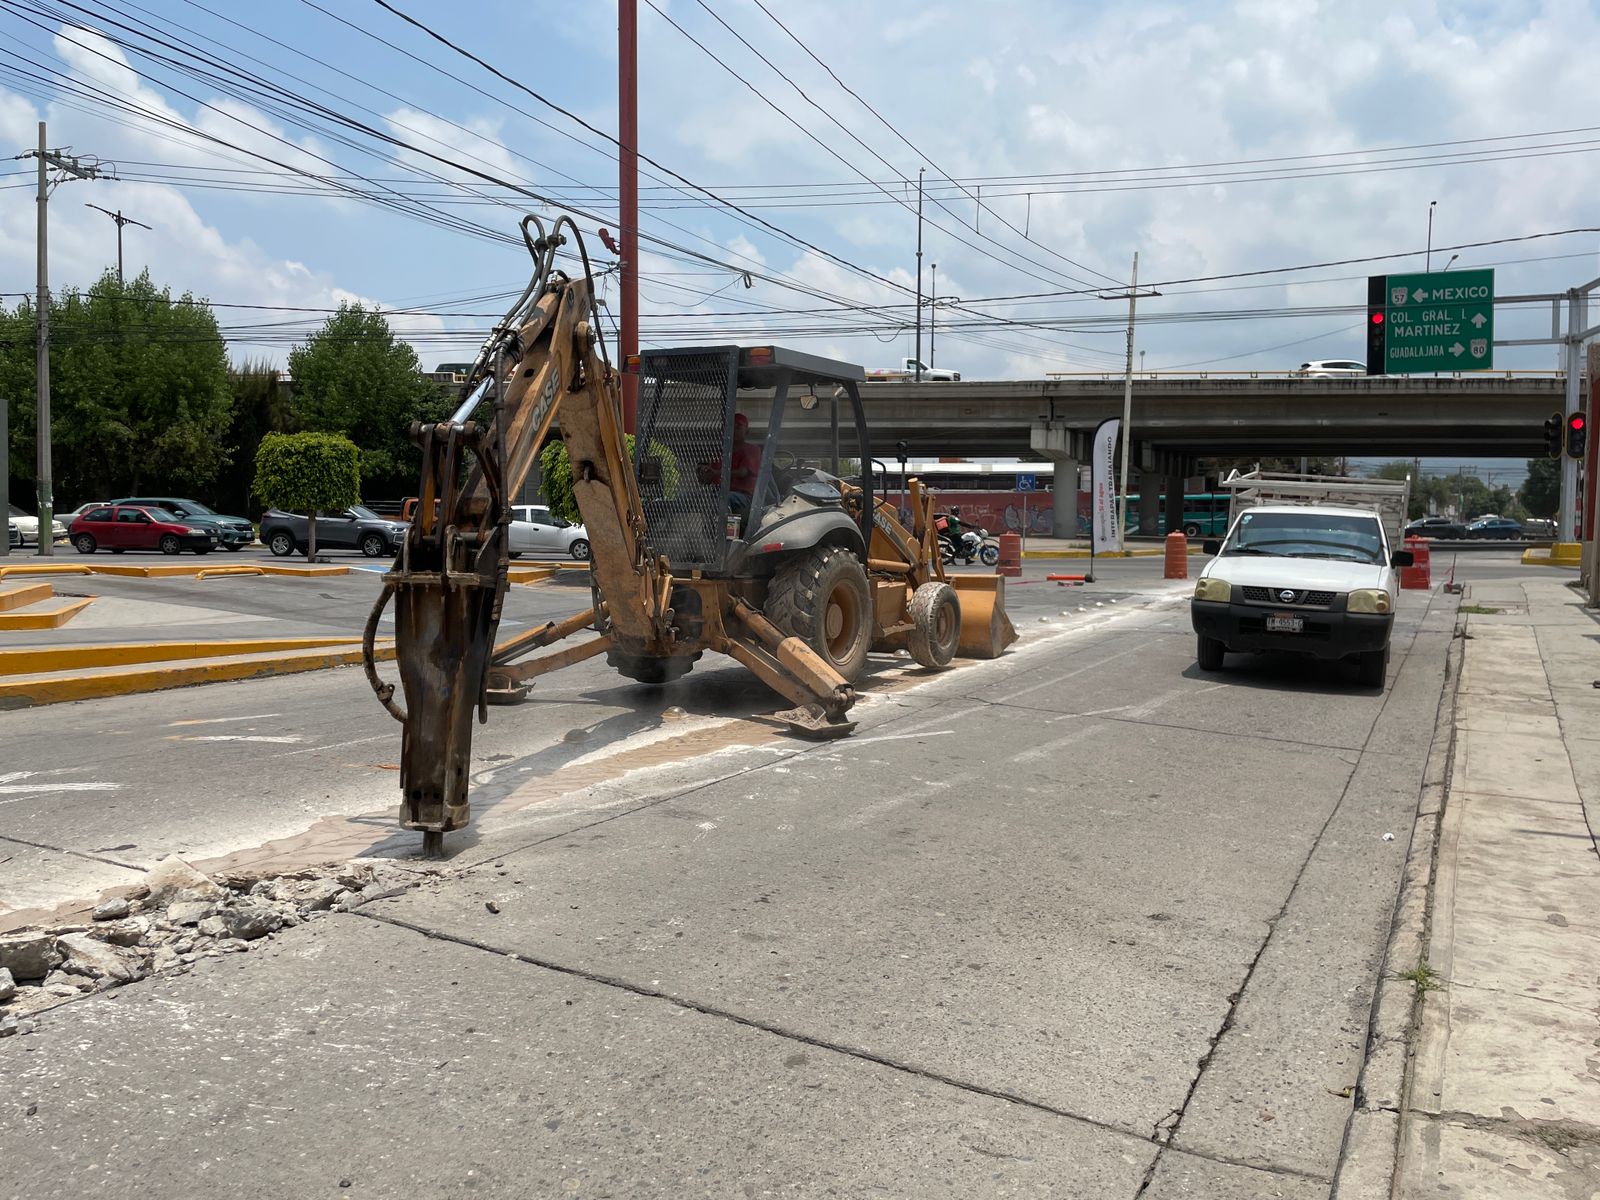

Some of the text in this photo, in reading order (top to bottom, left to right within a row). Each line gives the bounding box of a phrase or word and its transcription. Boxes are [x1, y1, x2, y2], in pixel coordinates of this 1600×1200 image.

[1394, 294, 1405, 303] 57
[1432, 286, 1488, 300] MEXICO
[1391, 311, 1413, 323] COL.
[1422, 309, 1453, 322] GRAL.
[1394, 323, 1460, 338] MARTINEZ
[1390, 345, 1444, 359] GUADALAJARA
[1473, 345, 1485, 355] 80
[532, 369, 560, 432] CASE
[872, 510, 892, 534] ASE
